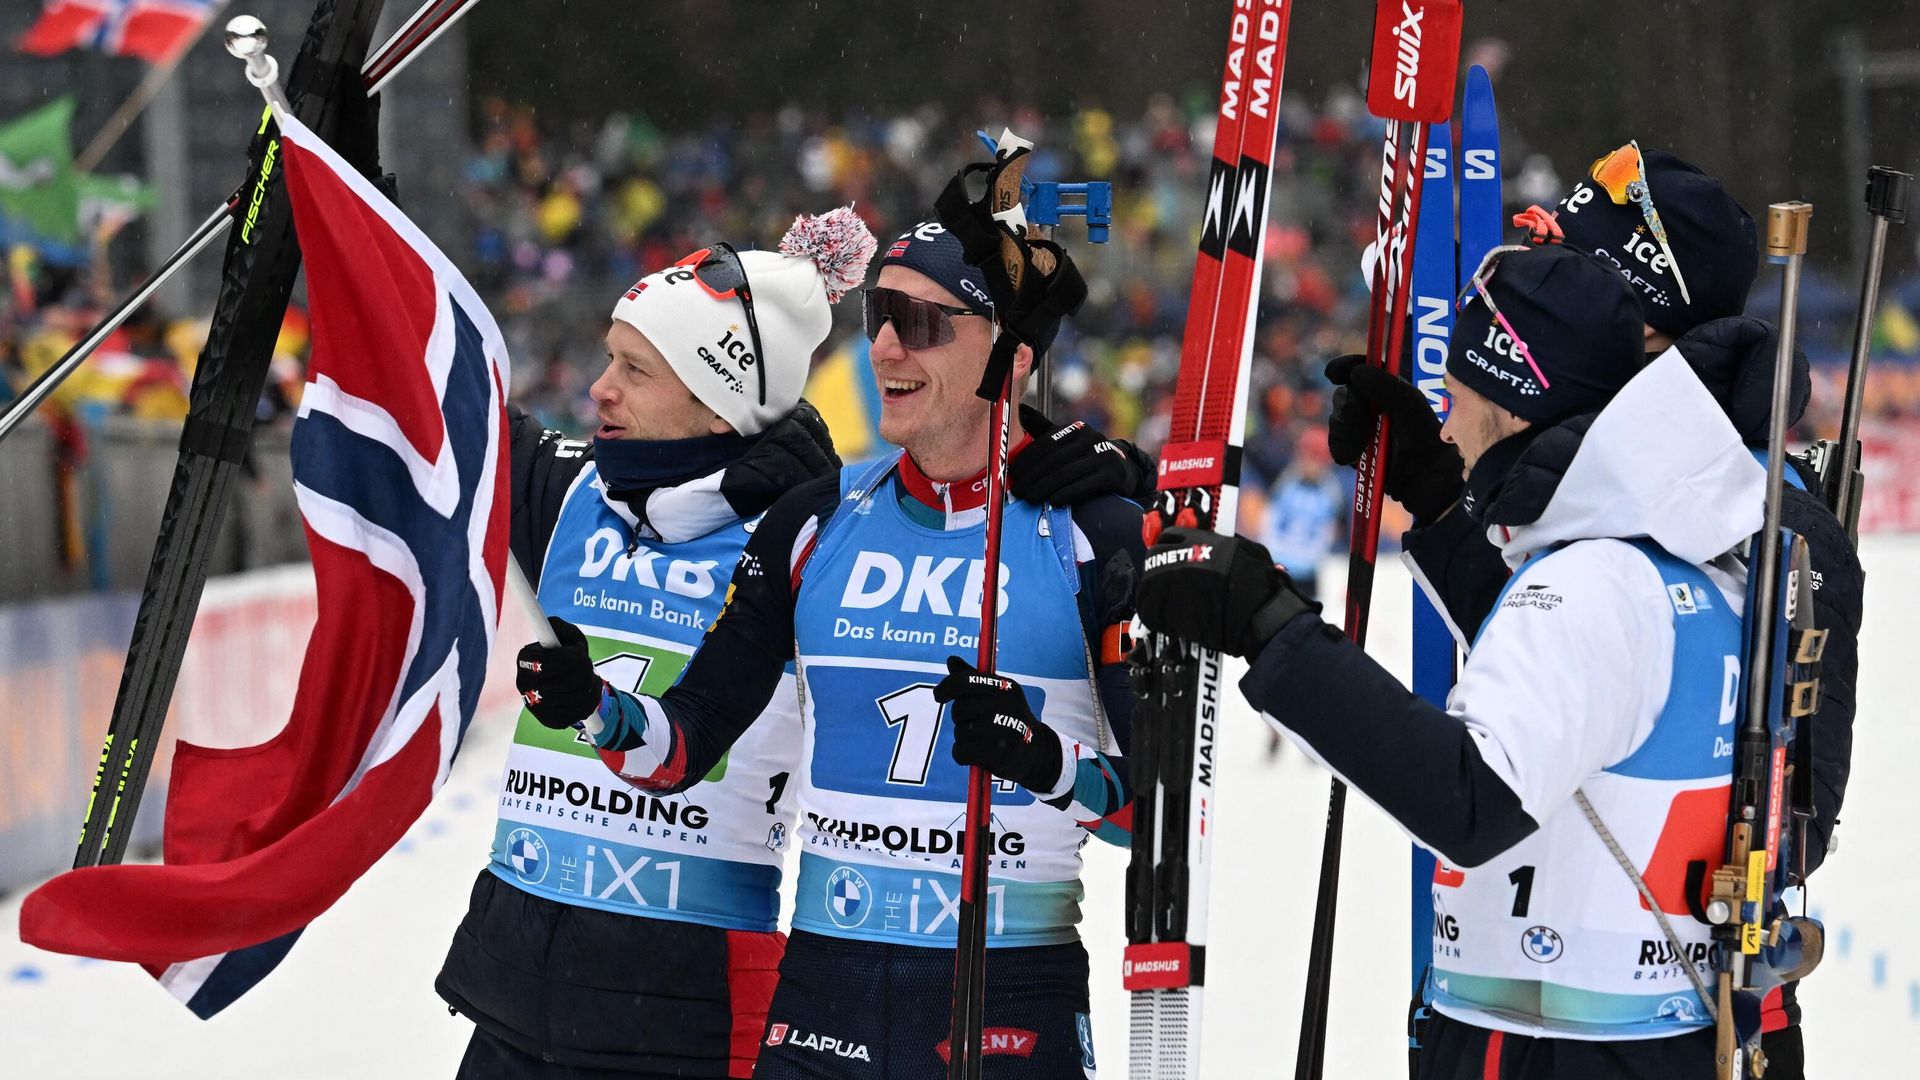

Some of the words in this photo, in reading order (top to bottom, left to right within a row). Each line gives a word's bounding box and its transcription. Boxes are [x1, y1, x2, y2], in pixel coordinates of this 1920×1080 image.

[241, 139, 279, 244] FISCHER
[697, 346, 736, 384] CRAFT
[717, 330, 755, 372] ice
[1466, 349, 1522, 388] CRAFT
[1168, 457, 1215, 472] MADSHUS
[1356, 472, 1365, 512] AERO
[579, 527, 720, 599] DKB
[840, 551, 1011, 618] DKB
[573, 588, 597, 608] Das
[600, 589, 642, 615] kann
[650, 600, 705, 630] Bank
[834, 619, 875, 640] Das
[882, 621, 936, 645] kann
[1198, 648, 1220, 788] MADSHUS
[1713, 736, 1733, 758] Das
[505, 768, 709, 829] RUHPOLDING
[766, 771, 790, 815] 1
[628, 823, 708, 845] ALPEN
[558, 855, 577, 894] THE
[583, 844, 681, 911] iX1
[1508, 865, 1535, 918] 1
[883, 891, 903, 932] THE
[1134, 960, 1180, 974] MADSHUS
[789, 1028, 871, 1063] LAPUA
